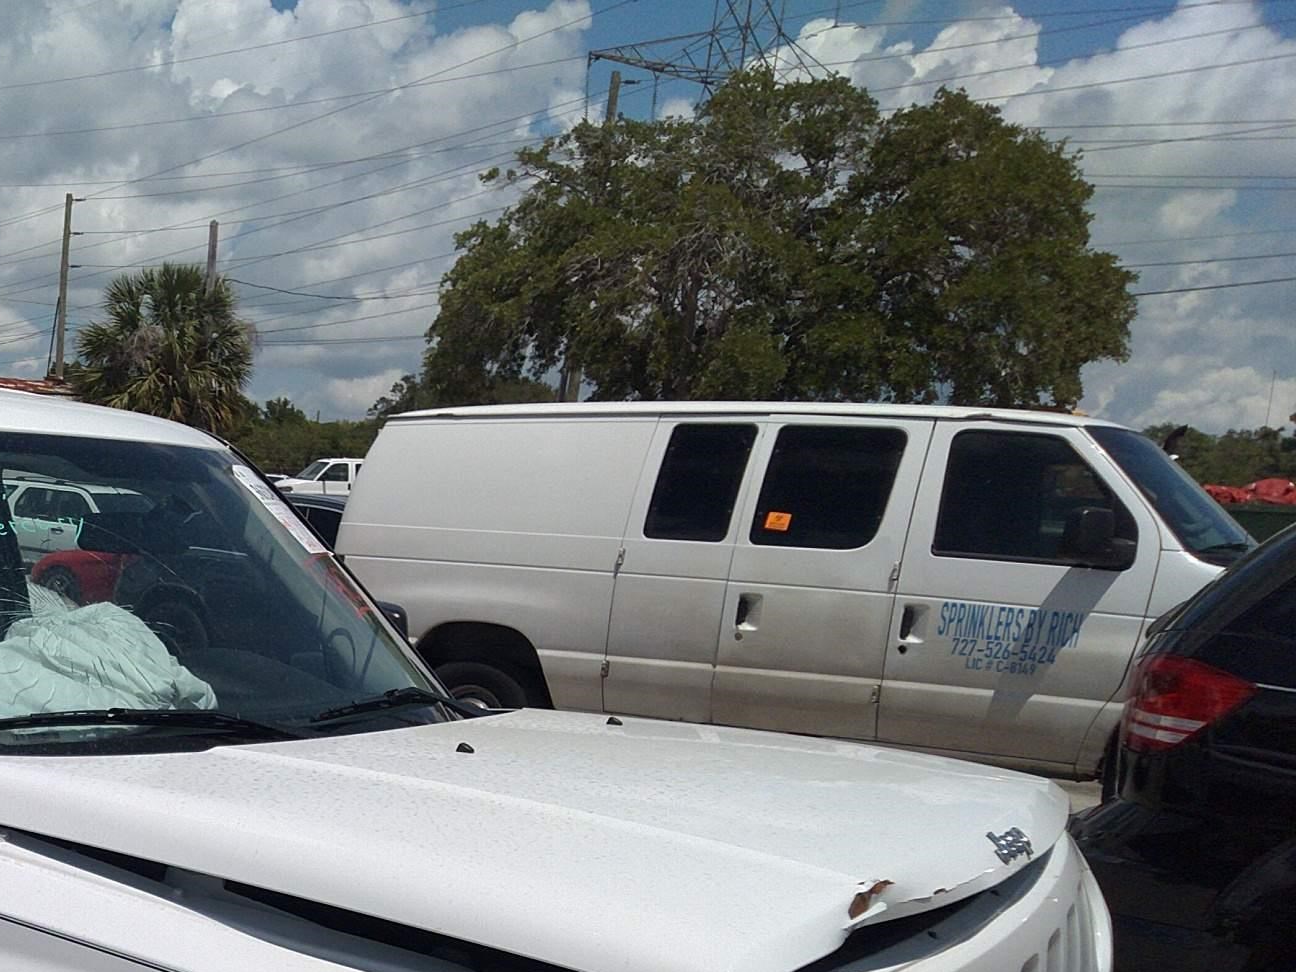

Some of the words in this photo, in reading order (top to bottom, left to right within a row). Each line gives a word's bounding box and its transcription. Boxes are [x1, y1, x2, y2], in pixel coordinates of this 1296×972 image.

[937, 601, 1025, 642] SPRINKLERS
[1023, 609, 1048, 644] BY
[1046, 611, 1084, 649] RICH
[951, 637, 1057, 665] 727-526-5424
